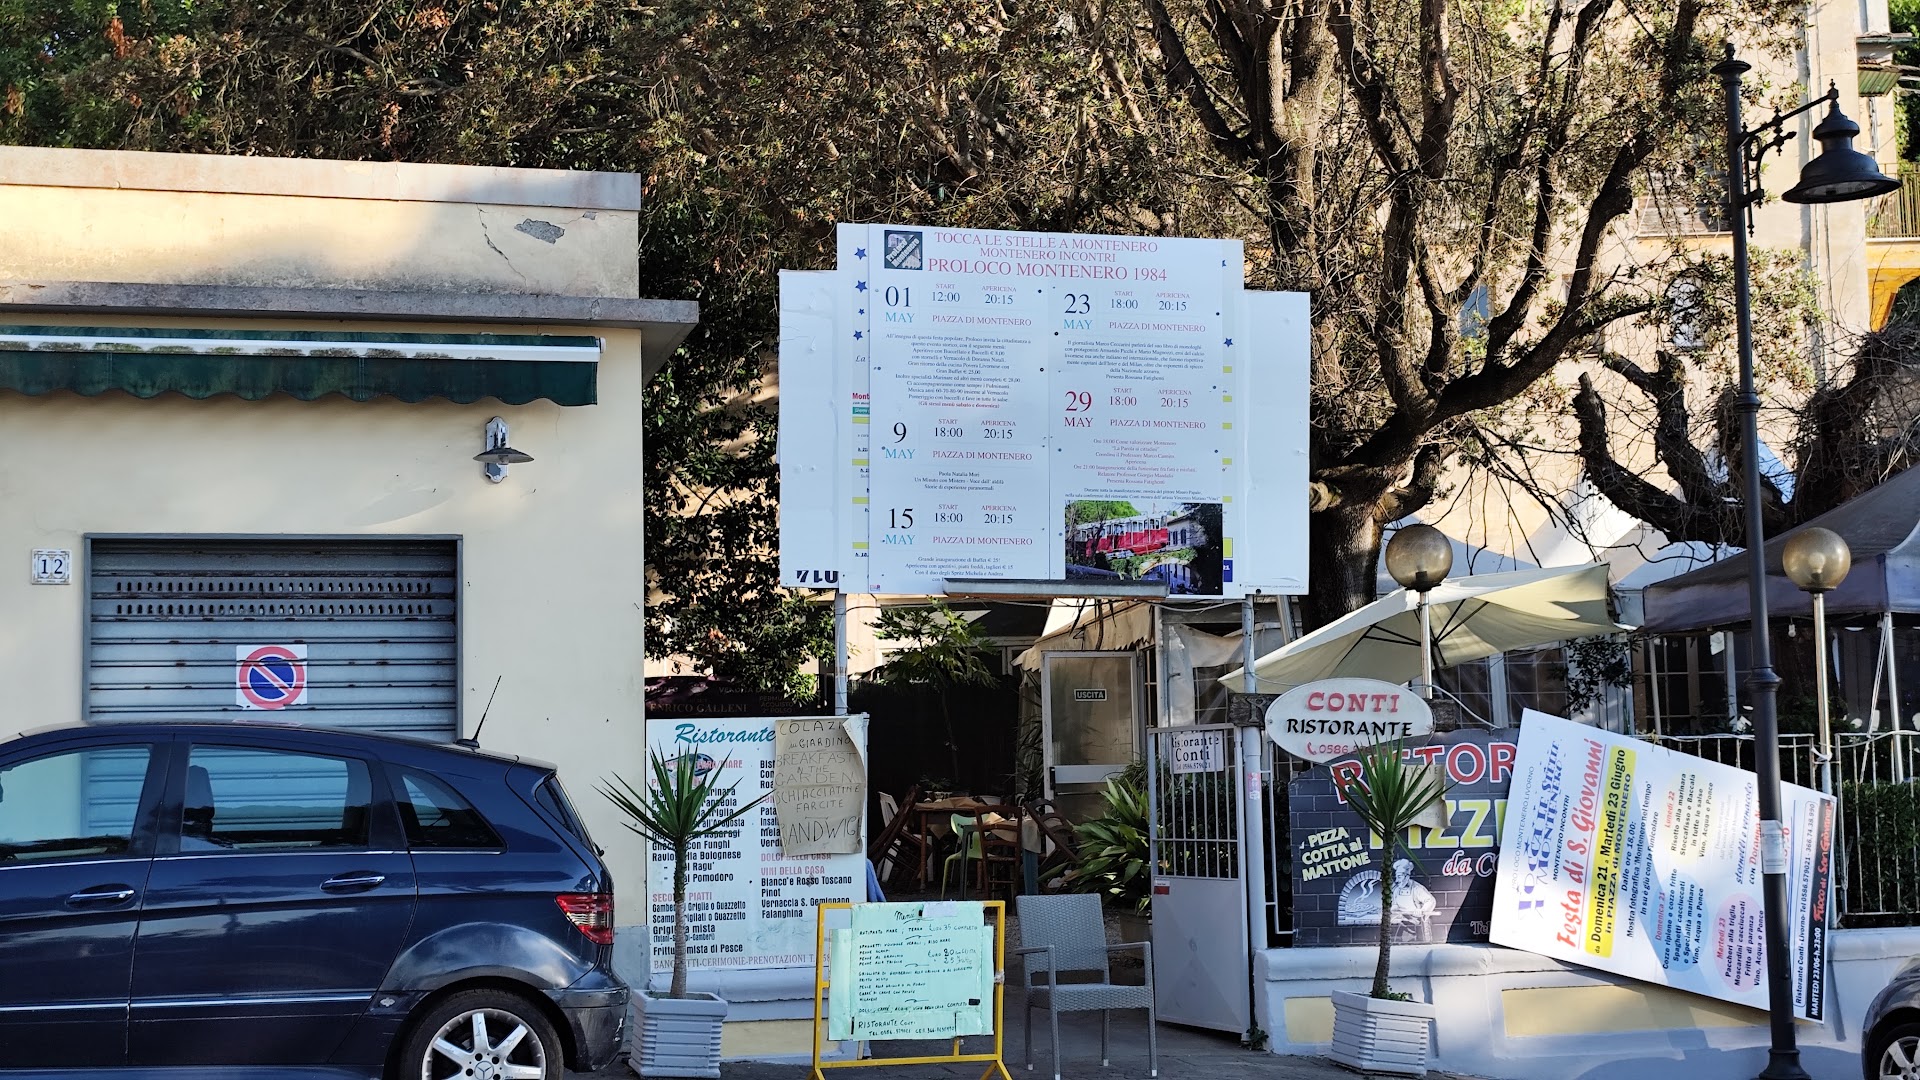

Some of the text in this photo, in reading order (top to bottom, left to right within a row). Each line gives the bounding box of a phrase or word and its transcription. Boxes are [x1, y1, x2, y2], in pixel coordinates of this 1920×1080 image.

[934, 232, 1158, 253] TOCCA LE STELLE A MONTENERO
[980, 247, 1116, 263] MONTENERO INCONTRI
[928, 258, 1167, 282] PROLOCO MONTENERO 1984
[885, 285, 1014, 308] 01 12:00 20:15
[981, 285, 1017, 293] APERICENA
[1064, 293, 1187, 315] 23 18:00 20:15
[885, 311, 1032, 327] MAY PIAZZA DI MONTENERO
[1063, 318, 1206, 333] MAY PIAZZA DI MONTENERO
[1157, 388, 1192, 396] APERICENA
[1064, 390, 1189, 413] 29 18:00 20:15
[981, 420, 1017, 428] APERICENA
[1064, 416, 1206, 430] MAY PIAZZA DI MONTENERO
[893, 421, 1013, 444] 9 18:00 20:15
[885, 448, 1033, 461] MAY PIAZZA DI MONTENERO
[888, 507, 1013, 530] 15 18:00 20:15
[885, 533, 1033, 546] MAY PIAZZA DI MONTENERO
[41, 558, 63, 575] 12
[1076, 689, 1104, 700] USCITA
[1307, 691, 1400, 713] CONTI
[674, 723, 776, 744] Ristorante
[1286, 718, 1413, 737] RISTORANTE
[1175, 746, 1210, 762] Conti
[1319, 744, 1349, 754] 0586
[777, 752, 857, 767] BREAKFAST
[1611, 749, 1626, 791] Giugno
[775, 772, 855, 787] GARDEN
[1608, 792, 1619, 810] 23
[1308, 826, 1350, 848] PIZZA
[1552, 795, 1570, 881] MONTENERO INCONTRI
[1557, 738, 1603, 947] Festa di S. Giovanni
[1600, 812, 1616, 857] Martedì
[704, 839, 730, 850] Funghi
[1301, 837, 1363, 865] COTTA al
[1607, 873, 1618, 918] PIAZZA
[1615, 773, 1631, 855] MONTENERO
[700, 851, 741, 861] Bolognese
[1442, 850, 1473, 876] da
[1818, 851, 1829, 875] San
[692, 861, 715, 872] Ragu'
[761, 865, 825, 876] VINI DELLA CASA
[1302, 851, 1371, 882] MATTONE
[1599, 866, 1608, 882] 21
[692, 873, 734, 883] Pomodoro
[796, 876, 820, 886] Rosso
[822, 875, 852, 885] Toscano
[1621, 869, 1630, 892] Dalle
[688, 892, 712, 901] PIATTI
[761, 888, 781, 898] Pinot
[687, 901, 746, 912] Griglia Guazzetto
[761, 898, 799, 908] Vernaccia
[800, 897, 808, 907] S.
[1626, 867, 1641, 938] Mostra fotografica
[1812, 889, 1826, 921] Fuoco
[714, 911, 746, 921] Guazzetto
[761, 909, 803, 919] Falanghina
[1591, 883, 1607, 942] Domenica
[692, 924, 716, 933] mista
[686, 943, 743, 955] mista di Pesce
[1673, 925, 1682, 962] Spaghetti
[1725, 944, 1734, 977] Paccheri
[1734, 944, 1743, 986] Moscardini
[1796, 946, 1805, 1004] Ristorante Conti
[1811, 980, 1820, 1016] MARTEDI
[858, 1019, 898, 1030] RISTORANTE
